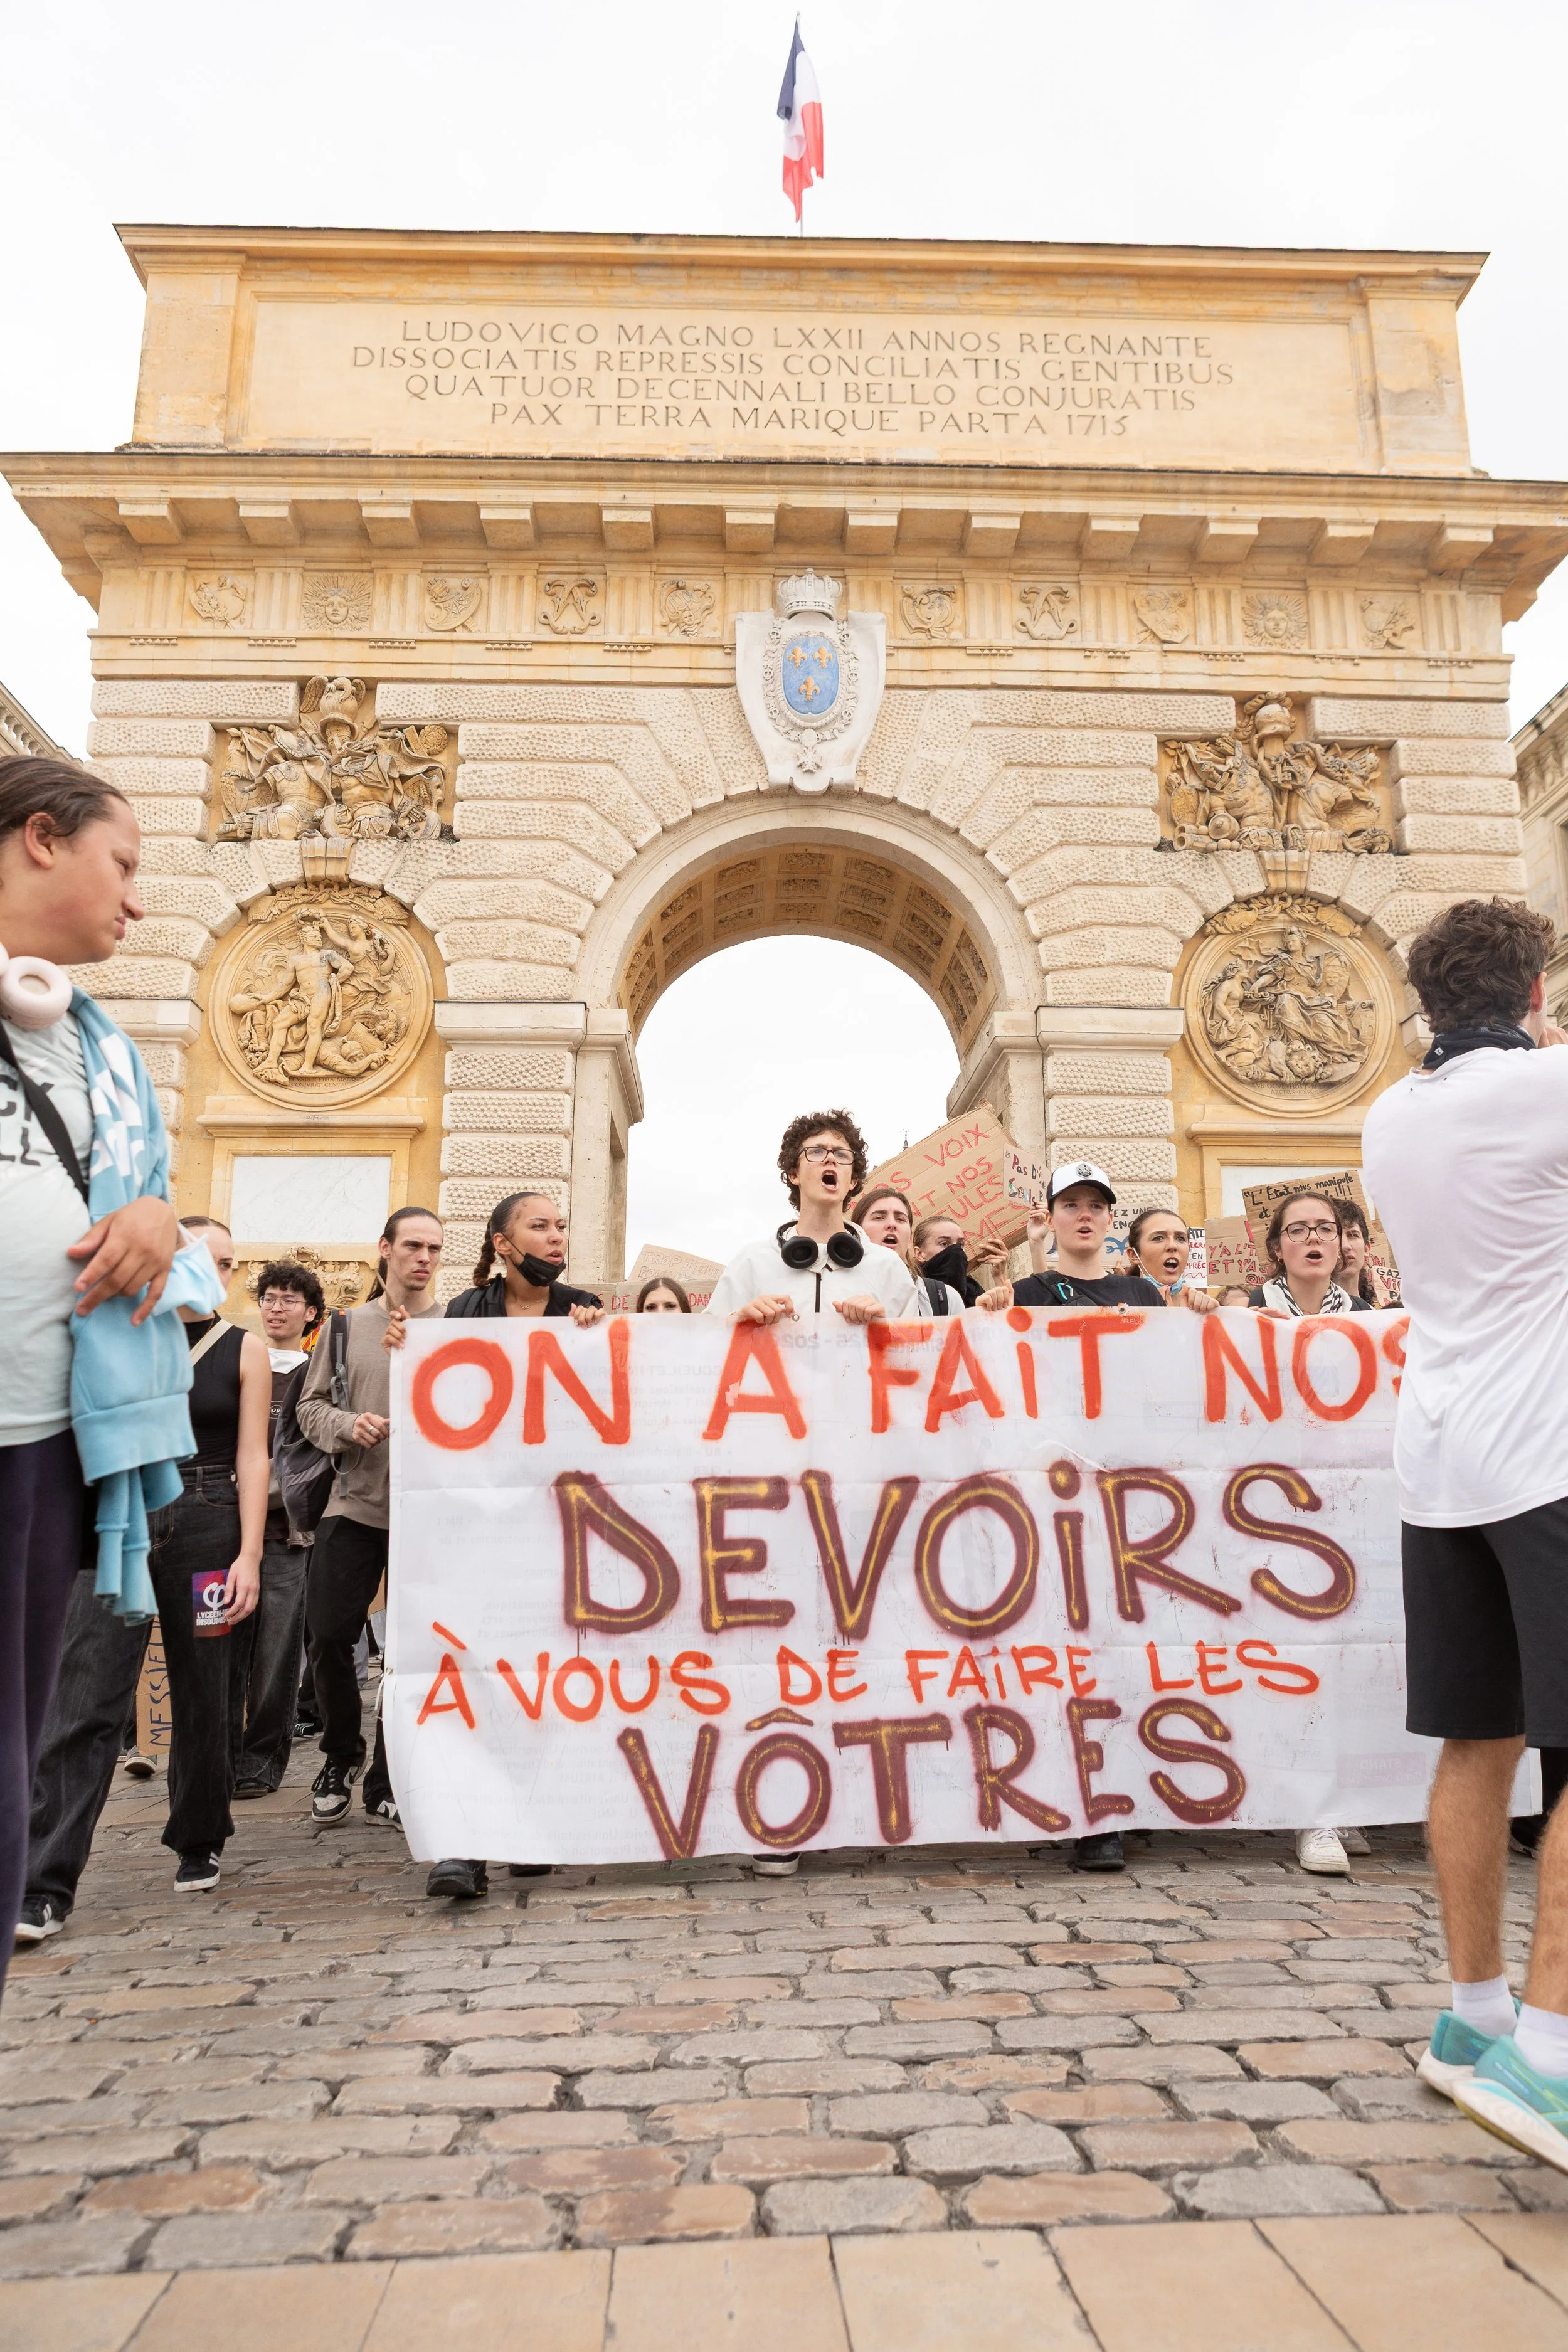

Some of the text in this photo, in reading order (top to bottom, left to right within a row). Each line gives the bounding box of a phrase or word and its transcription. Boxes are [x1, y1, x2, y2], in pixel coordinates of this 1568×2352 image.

[402, 320, 1212, 359] LUDOVICO MAGNO LXXII ANNOS REGNANTE
[352, 346, 1234, 385] DISSOCIATIS REPRESSIS CONCILIATIS GENTIBUS
[405, 374, 1195, 411] QUATUOR DECENNALI BELLO CONJURATIS
[490, 403, 1130, 437] PAX TERRA MARIQUE PARTA 1715
[923, 1123, 990, 1167] VOIX
[946, 1156, 993, 1194] NOS
[1012, 1153, 1028, 1175] Pas
[1293, 1183, 1311, 1193] nous
[1315, 1172, 1353, 1195] manipule
[1111, 1209, 1128, 1217] EZ
[643, 1251, 682, 1268] TROP
[1209, 1259, 1234, 1274] ET
[611, 1295, 630, 1310] DE
[411, 1315, 632, 1451] ON
[702, 1319, 807, 1441] A
[416, 1621, 475, 1729] À
[497, 1649, 731, 1722] VOUS
[776, 1645, 868, 1705] DE
[1146, 1638, 1320, 1695] LES
[617, 1697, 1246, 1862] VÔTRES
